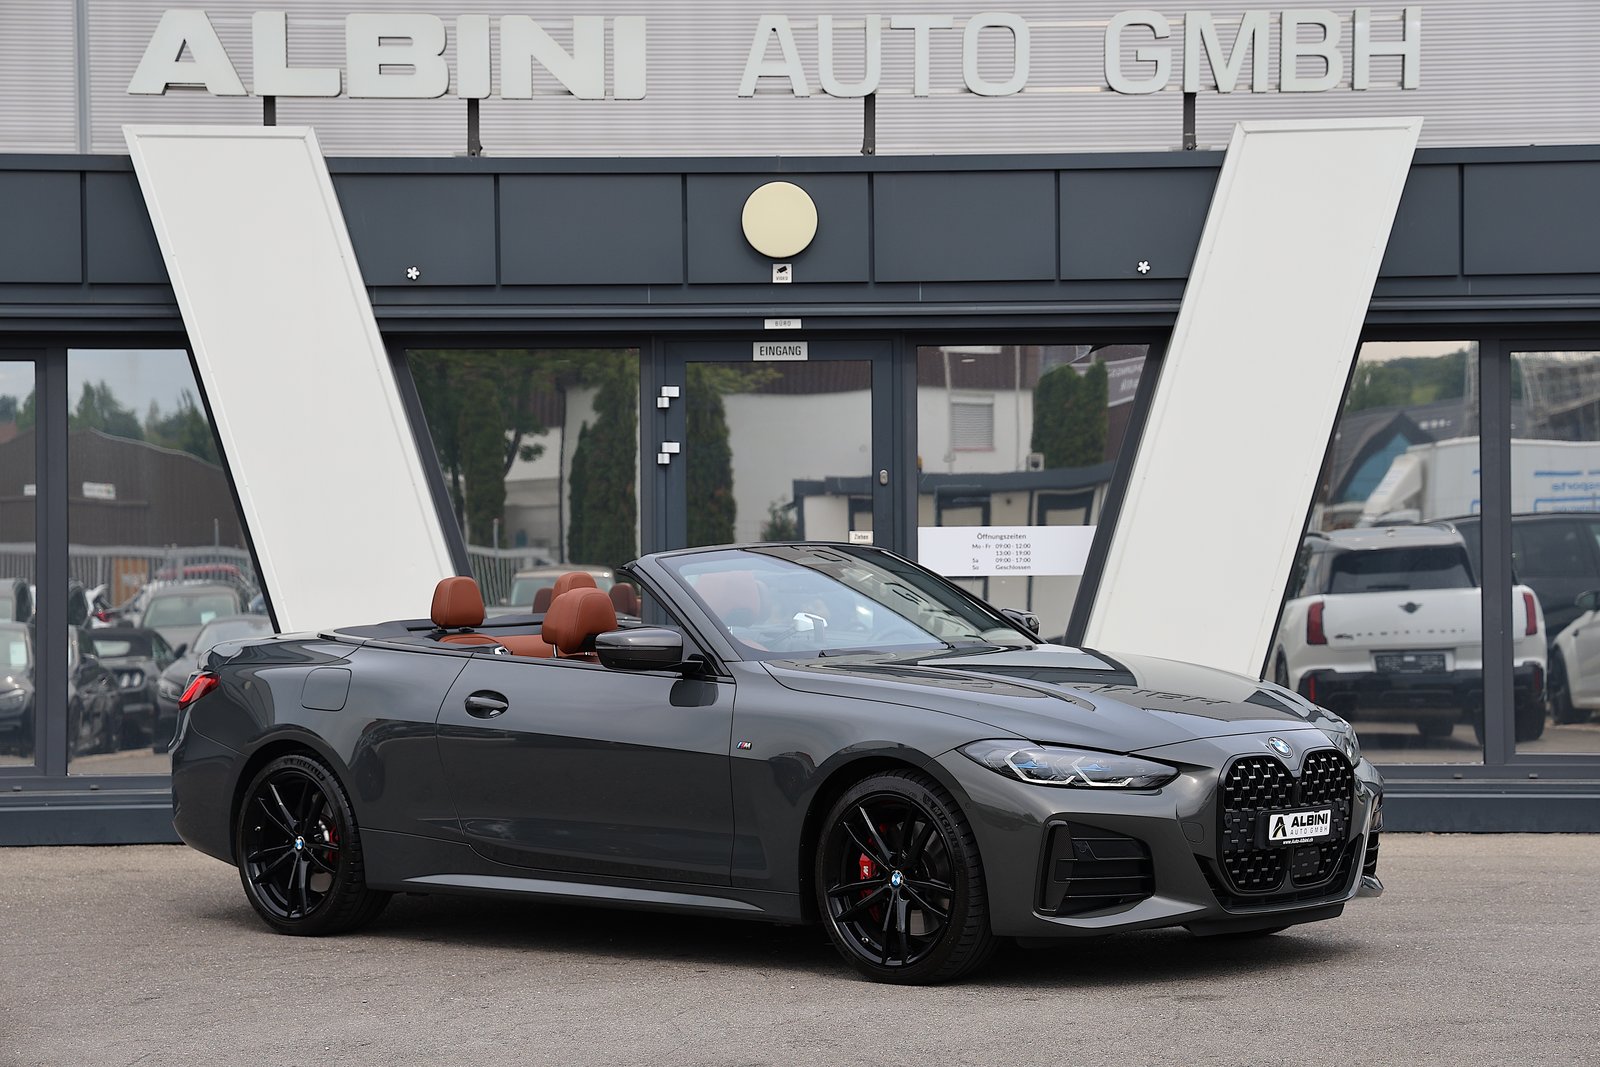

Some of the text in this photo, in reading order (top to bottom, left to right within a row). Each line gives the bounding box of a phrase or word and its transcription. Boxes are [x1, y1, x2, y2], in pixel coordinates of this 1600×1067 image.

[127, 7, 1421, 100] ALBINI AUTO GMBH
[759, 346, 801, 356] EINGANG
[977, 532, 1026, 540] Öffnungszeiten
[1291, 813, 1328, 827] ALBINI
[1310, 826, 1327, 834] GMBH
